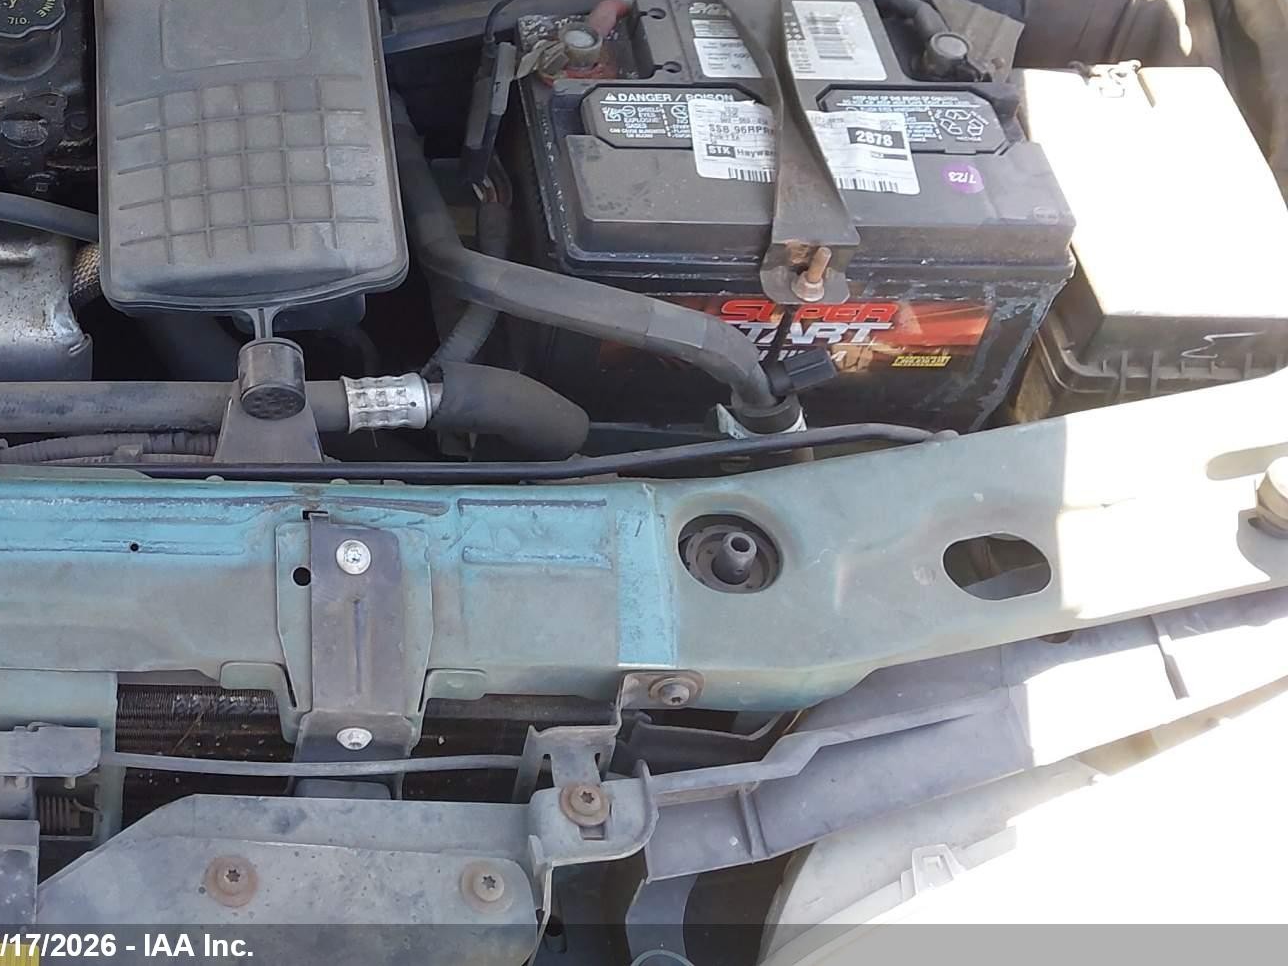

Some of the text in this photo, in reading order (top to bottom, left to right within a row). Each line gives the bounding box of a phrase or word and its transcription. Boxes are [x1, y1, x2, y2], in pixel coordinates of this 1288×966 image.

[7, 16, 27, 25] OIL
[618, 93, 672, 102] DANGER
[856, 131, 893, 147] 2878
[709, 146, 731, 155] STK
[725, 321, 894, 344] TART
